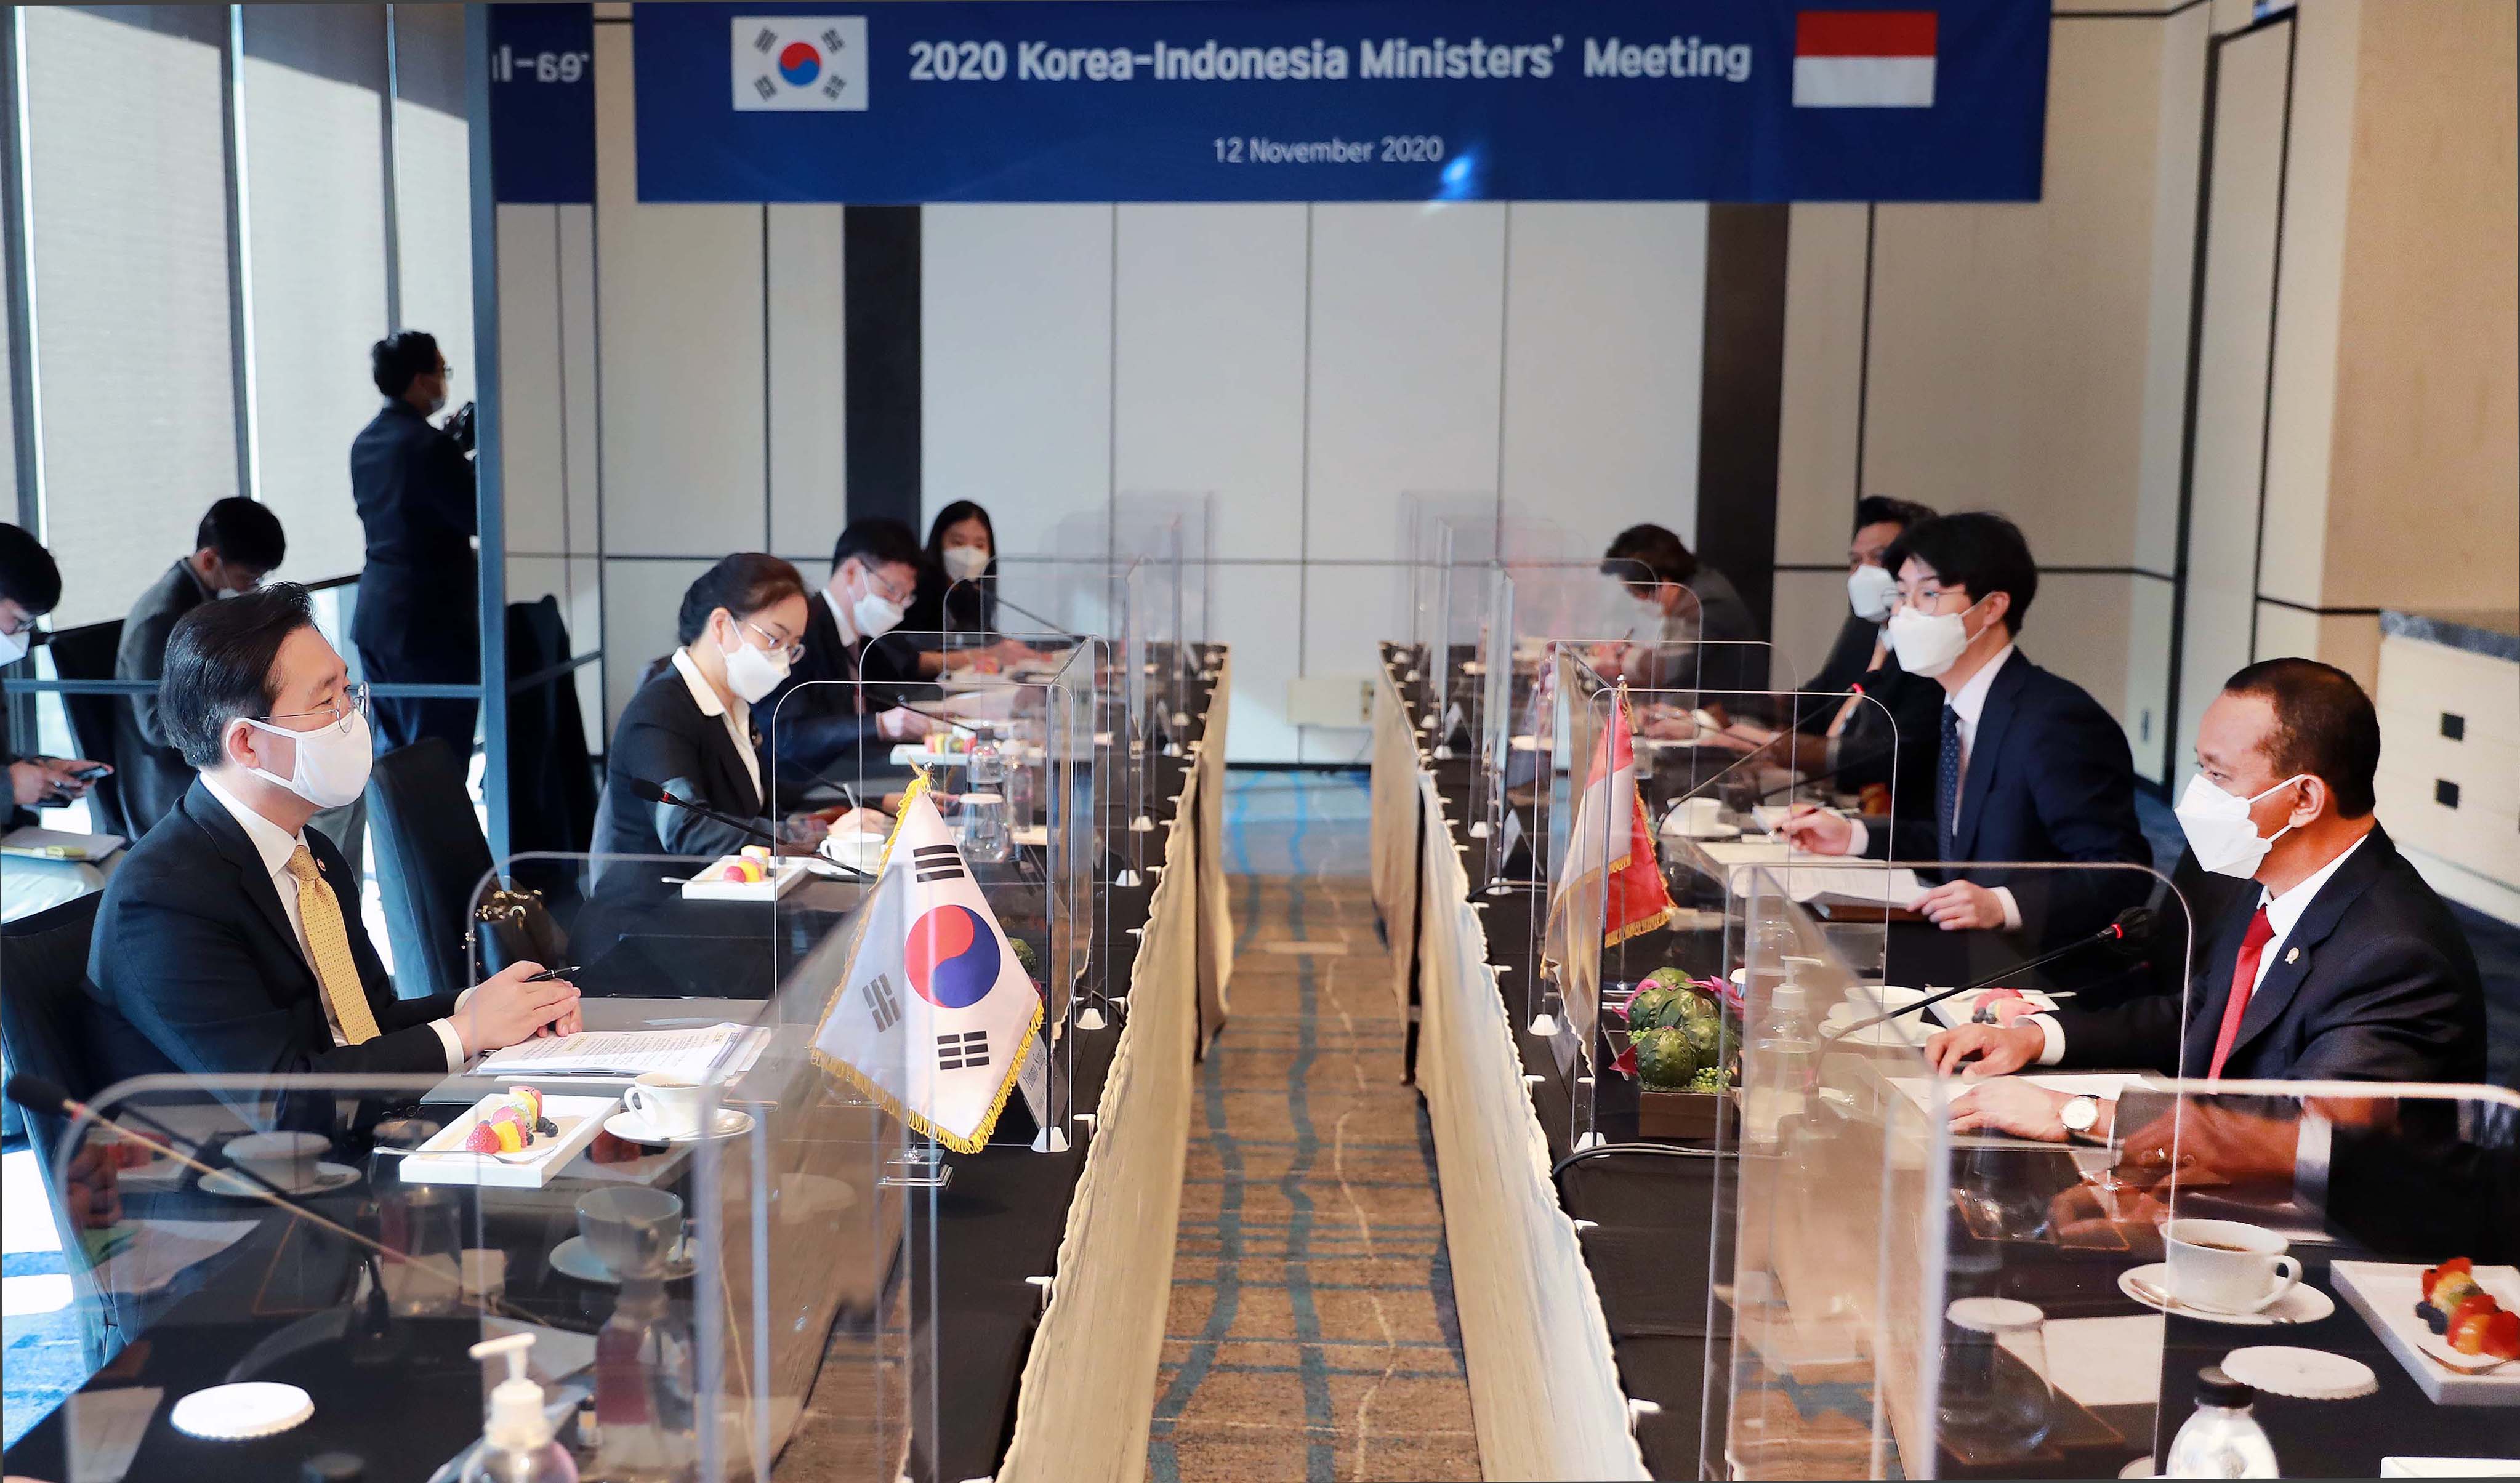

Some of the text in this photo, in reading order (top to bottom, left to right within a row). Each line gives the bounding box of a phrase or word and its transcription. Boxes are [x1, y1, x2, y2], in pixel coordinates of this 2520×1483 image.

[909, 35, 1752, 82] 2020 Korea-Indonesia Ministers’ Meeting
[1214, 135, 1444, 163] 12 November 2020
